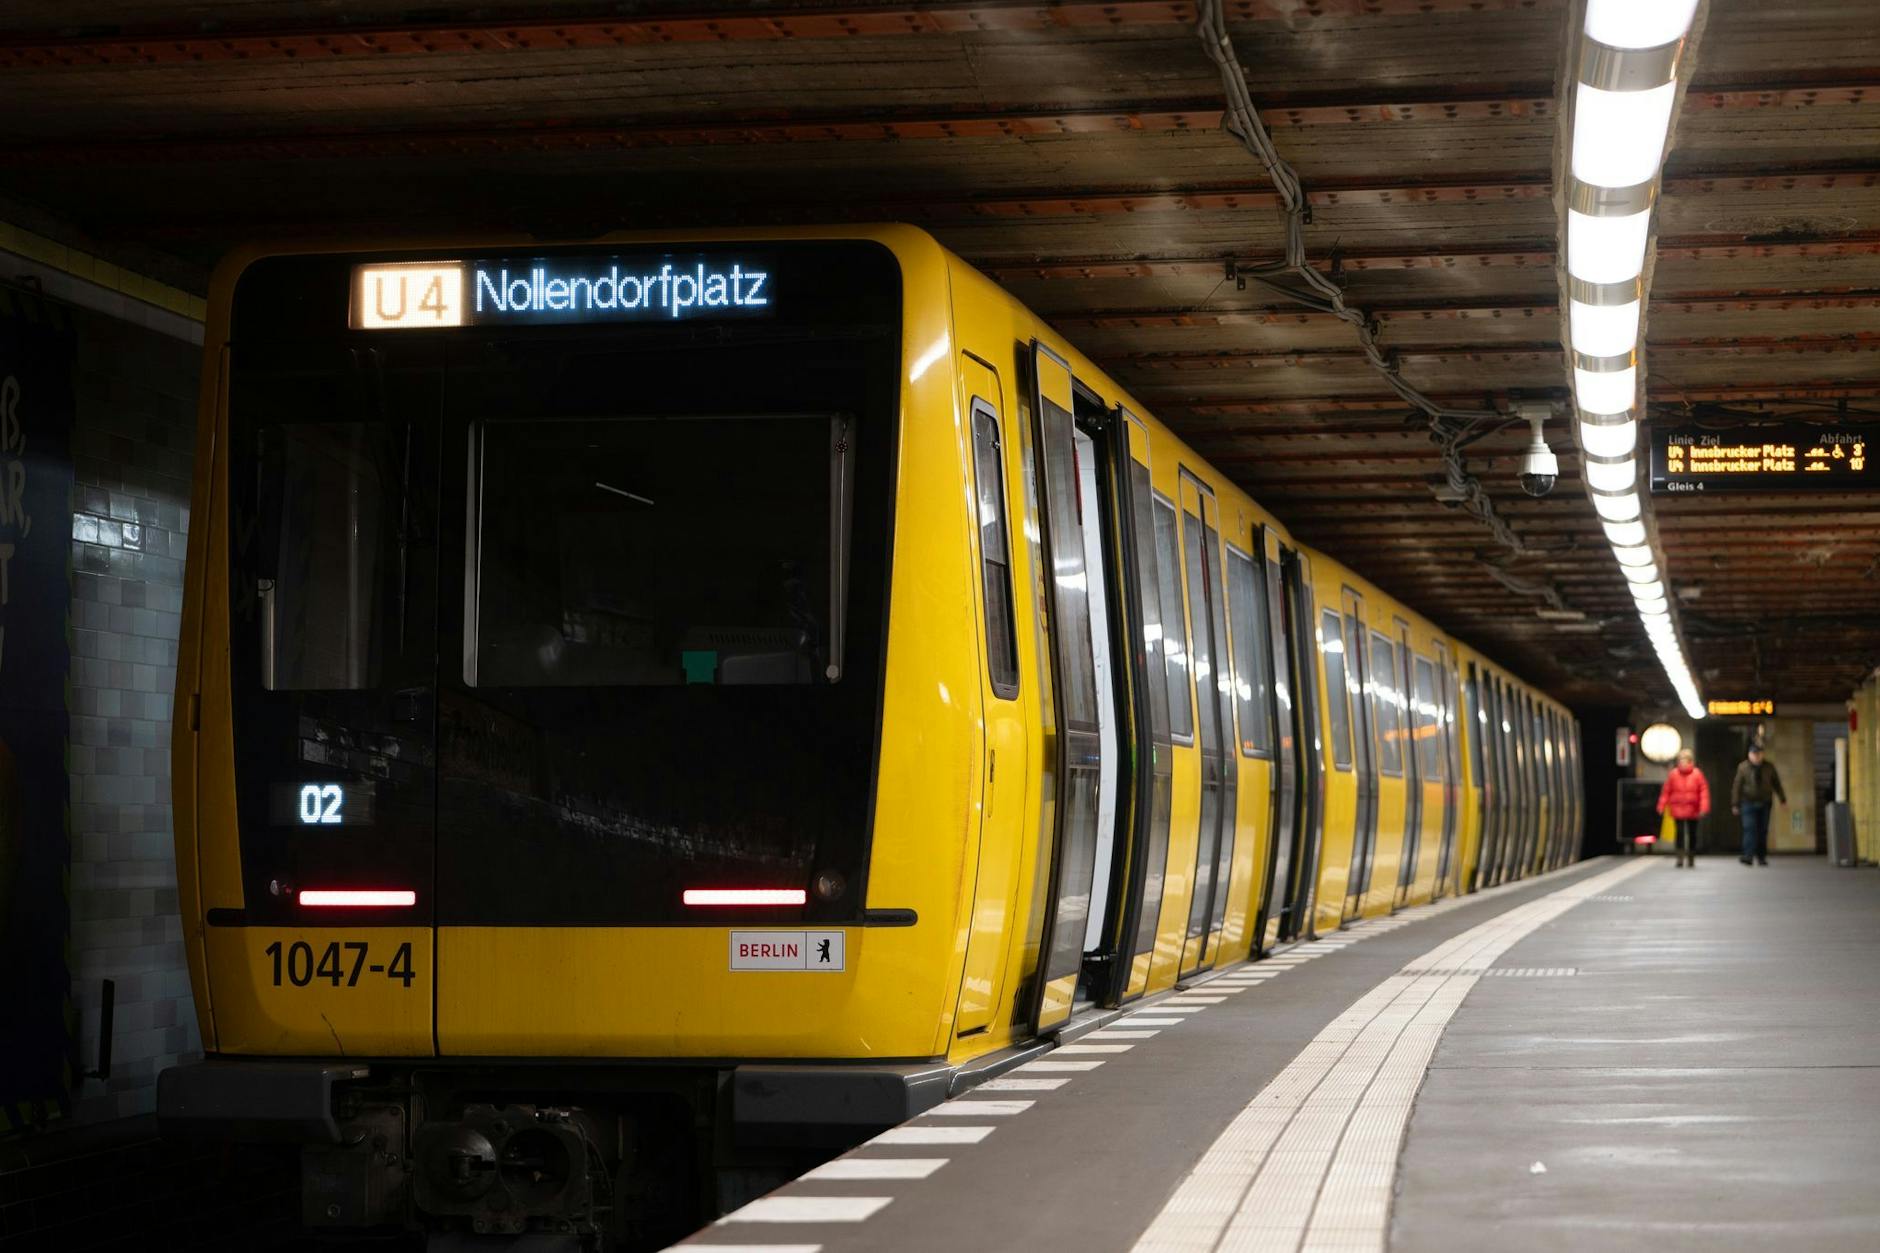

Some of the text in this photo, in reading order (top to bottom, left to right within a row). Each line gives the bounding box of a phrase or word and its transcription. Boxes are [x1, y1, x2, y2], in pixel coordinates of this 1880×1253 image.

[477, 264, 767, 317] Nollendorfplatz
[1669, 435, 1720, 445] Linie Ziel
[1820, 433, 1862, 444] Abfahrt
[1690, 445, 1761, 458] Innsbrucker
[1763, 444, 1795, 457] Platz
[1690, 459, 1761, 472] Innsbrucker
[1763, 458, 1795, 471] Platz
[1667, 482, 1704, 491] Gleis 4
[300, 785, 343, 823] 02
[740, 943, 798, 958] BERLIN
[265, 941, 416, 988] 1047-4
